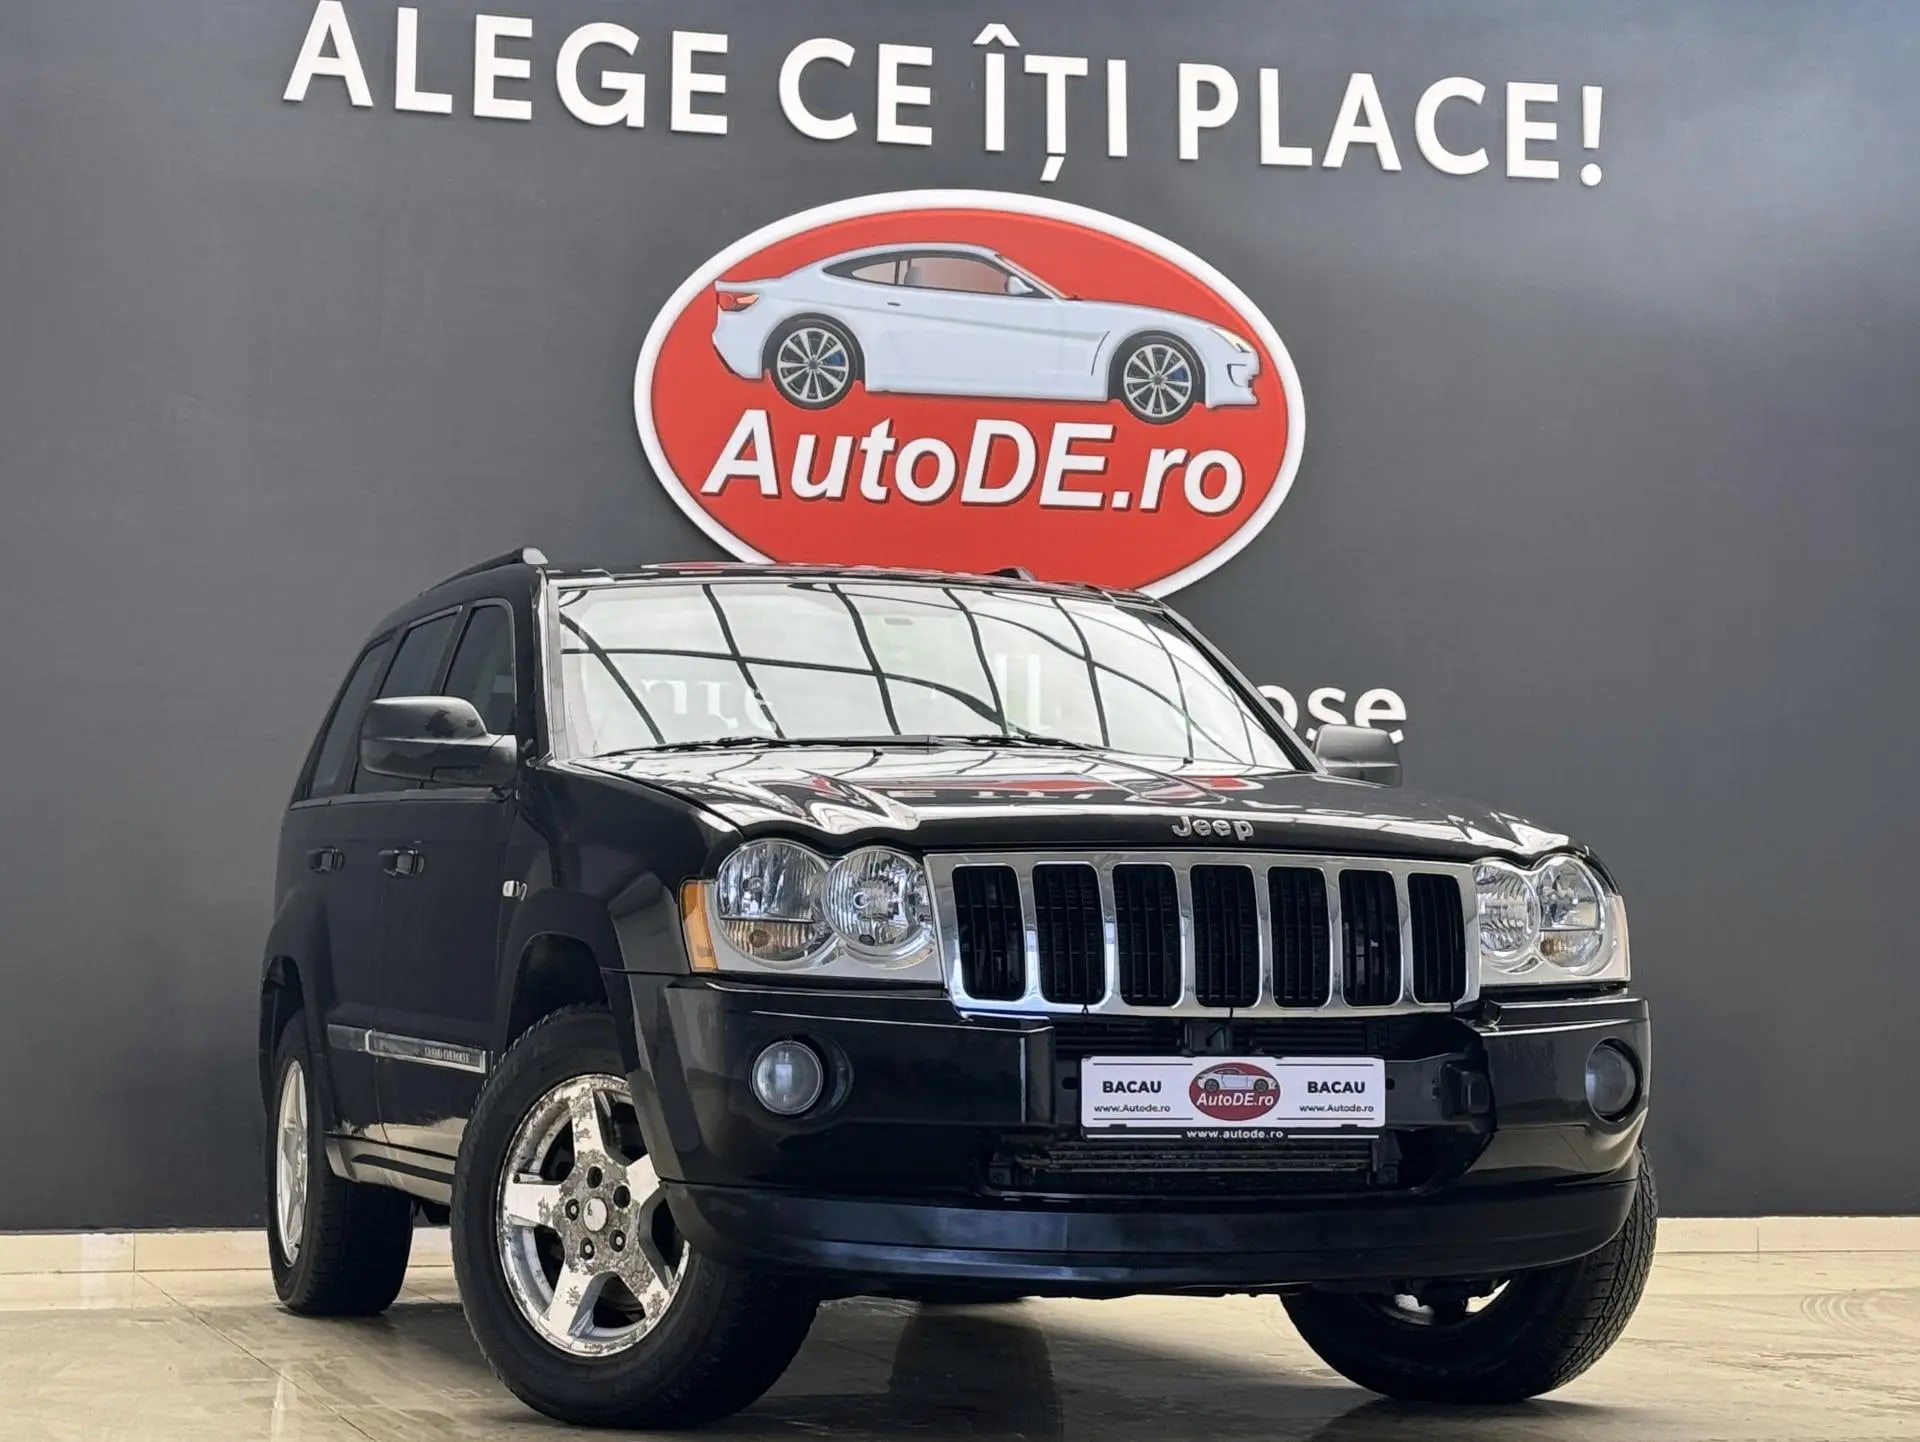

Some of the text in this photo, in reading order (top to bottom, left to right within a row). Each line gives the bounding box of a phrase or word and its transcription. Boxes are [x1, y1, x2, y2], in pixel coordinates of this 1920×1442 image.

[282, 0, 1603, 187] ALEGE CE ÎȚI PLACE!
[700, 409, 1246, 514] AutoDE.ro
[1171, 815, 1254, 841] Jeep
[1102, 1080, 1162, 1094] BACAU
[1307, 1080, 1366, 1094] BACAU
[1196, 1092, 1274, 1107] AutoDE.ro
[1093, 1104, 1172, 1113] www.Autode.ro
[1299, 1104, 1375, 1113] www.Autode.ro
[1186, 1128, 1284, 1139] www.autode.ro
